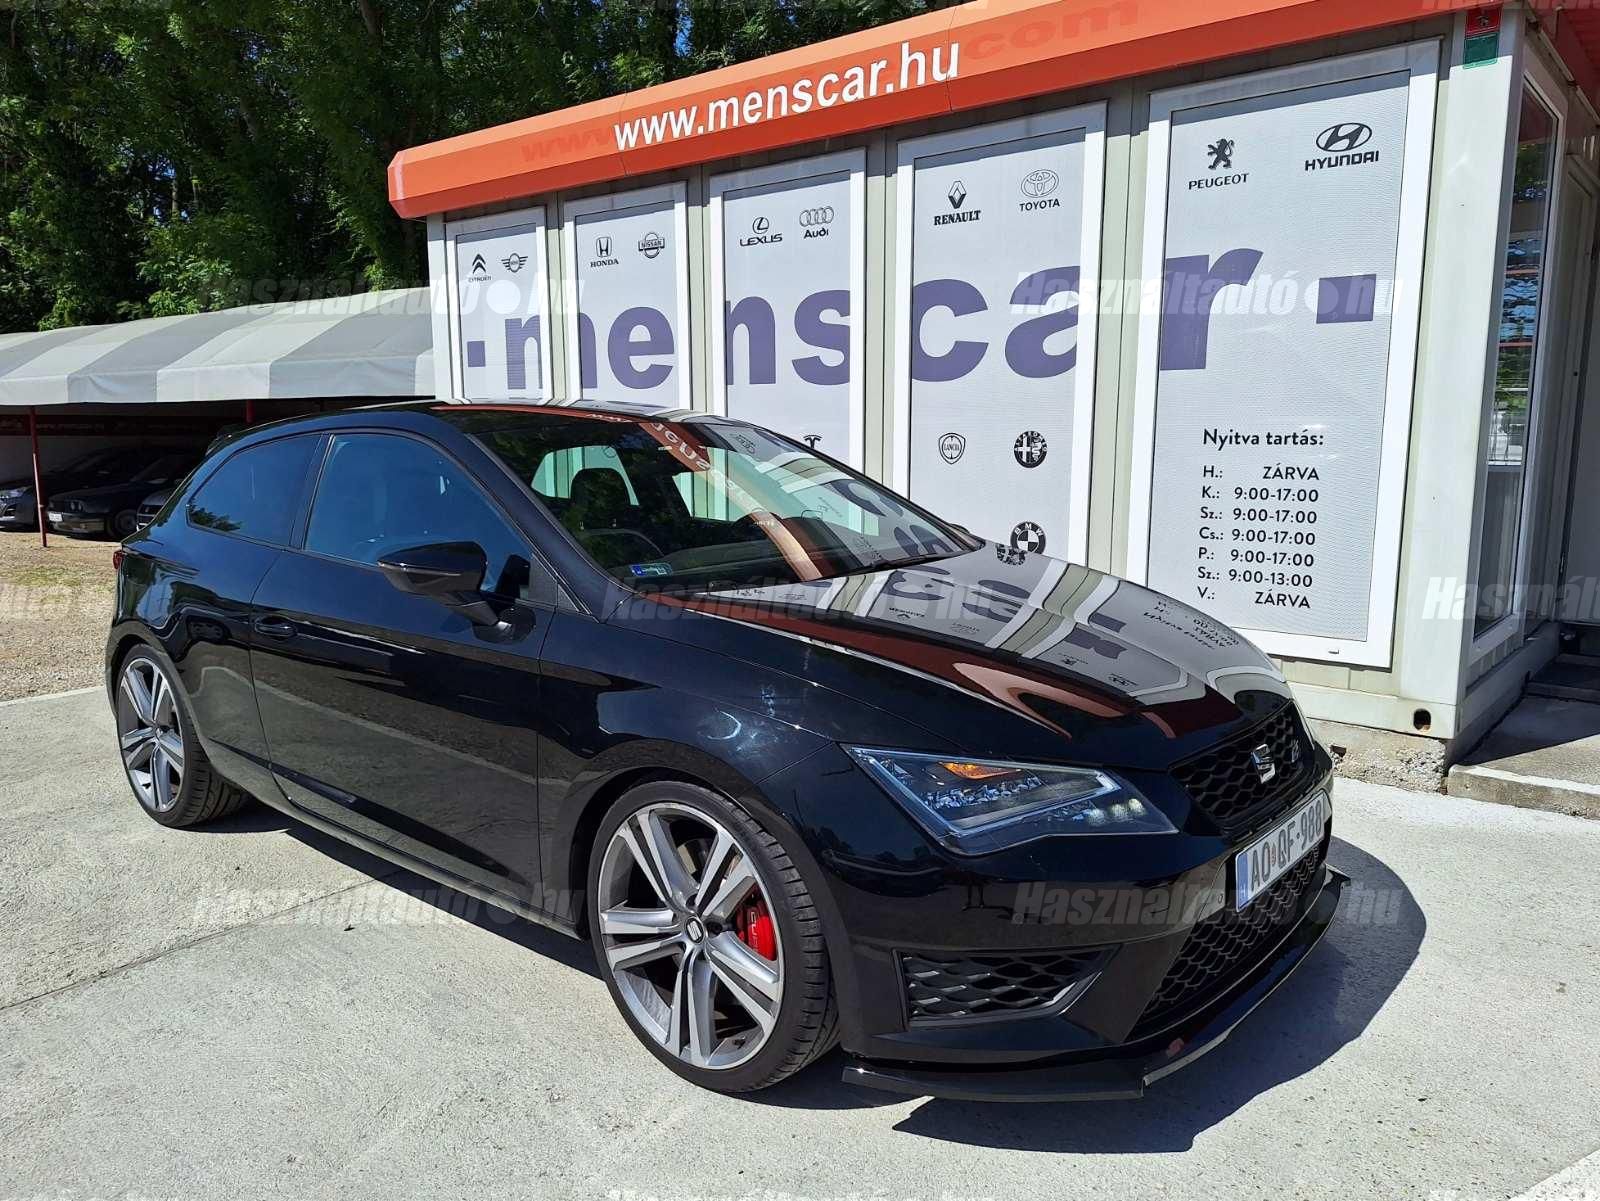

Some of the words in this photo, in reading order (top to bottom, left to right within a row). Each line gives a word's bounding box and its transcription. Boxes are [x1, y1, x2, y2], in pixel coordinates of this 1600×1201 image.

[612, 40, 959, 151] www.menscar.hu
[1304, 151, 1379, 171] HYUNDAI
[1188, 173, 1249, 190] PEUGEOT
[1019, 198, 1060, 212] TOYOTA
[933, 210, 981, 226] RENAULT
[739, 232, 783, 247] LEXUS
[803, 227, 829, 239] Audi
[640, 240, 663, 250] NISSAN
[590, 258, 619, 268] HONDA
[1203, 428, 1260, 451] Nyitva
[1266, 429, 1324, 445] tartás:
[1203, 465, 1223, 478] H.:
[1263, 462, 1320, 480] ZÁRVA
[1202, 485, 1220, 499] K.:
[1234, 486, 1319, 502] 9:00-17:00
[1200, 506, 1223, 519] Sz.:
[1233, 507, 1317, 524] 9:00-17:00
[1199, 526, 1224, 540] Cs.:
[1231, 528, 1315, 545] 9:00-17:00
[1198, 547, 1214, 560] P.:
[1230, 549, 1314, 567] 9:00-17:00
[1197, 566, 1220, 580] Sz.:
[1228, 569, 1312, 587] 9:00-13:00
[1197, 586, 1215, 600] V.:
[1255, 589, 1311, 608] ZÁRVA
